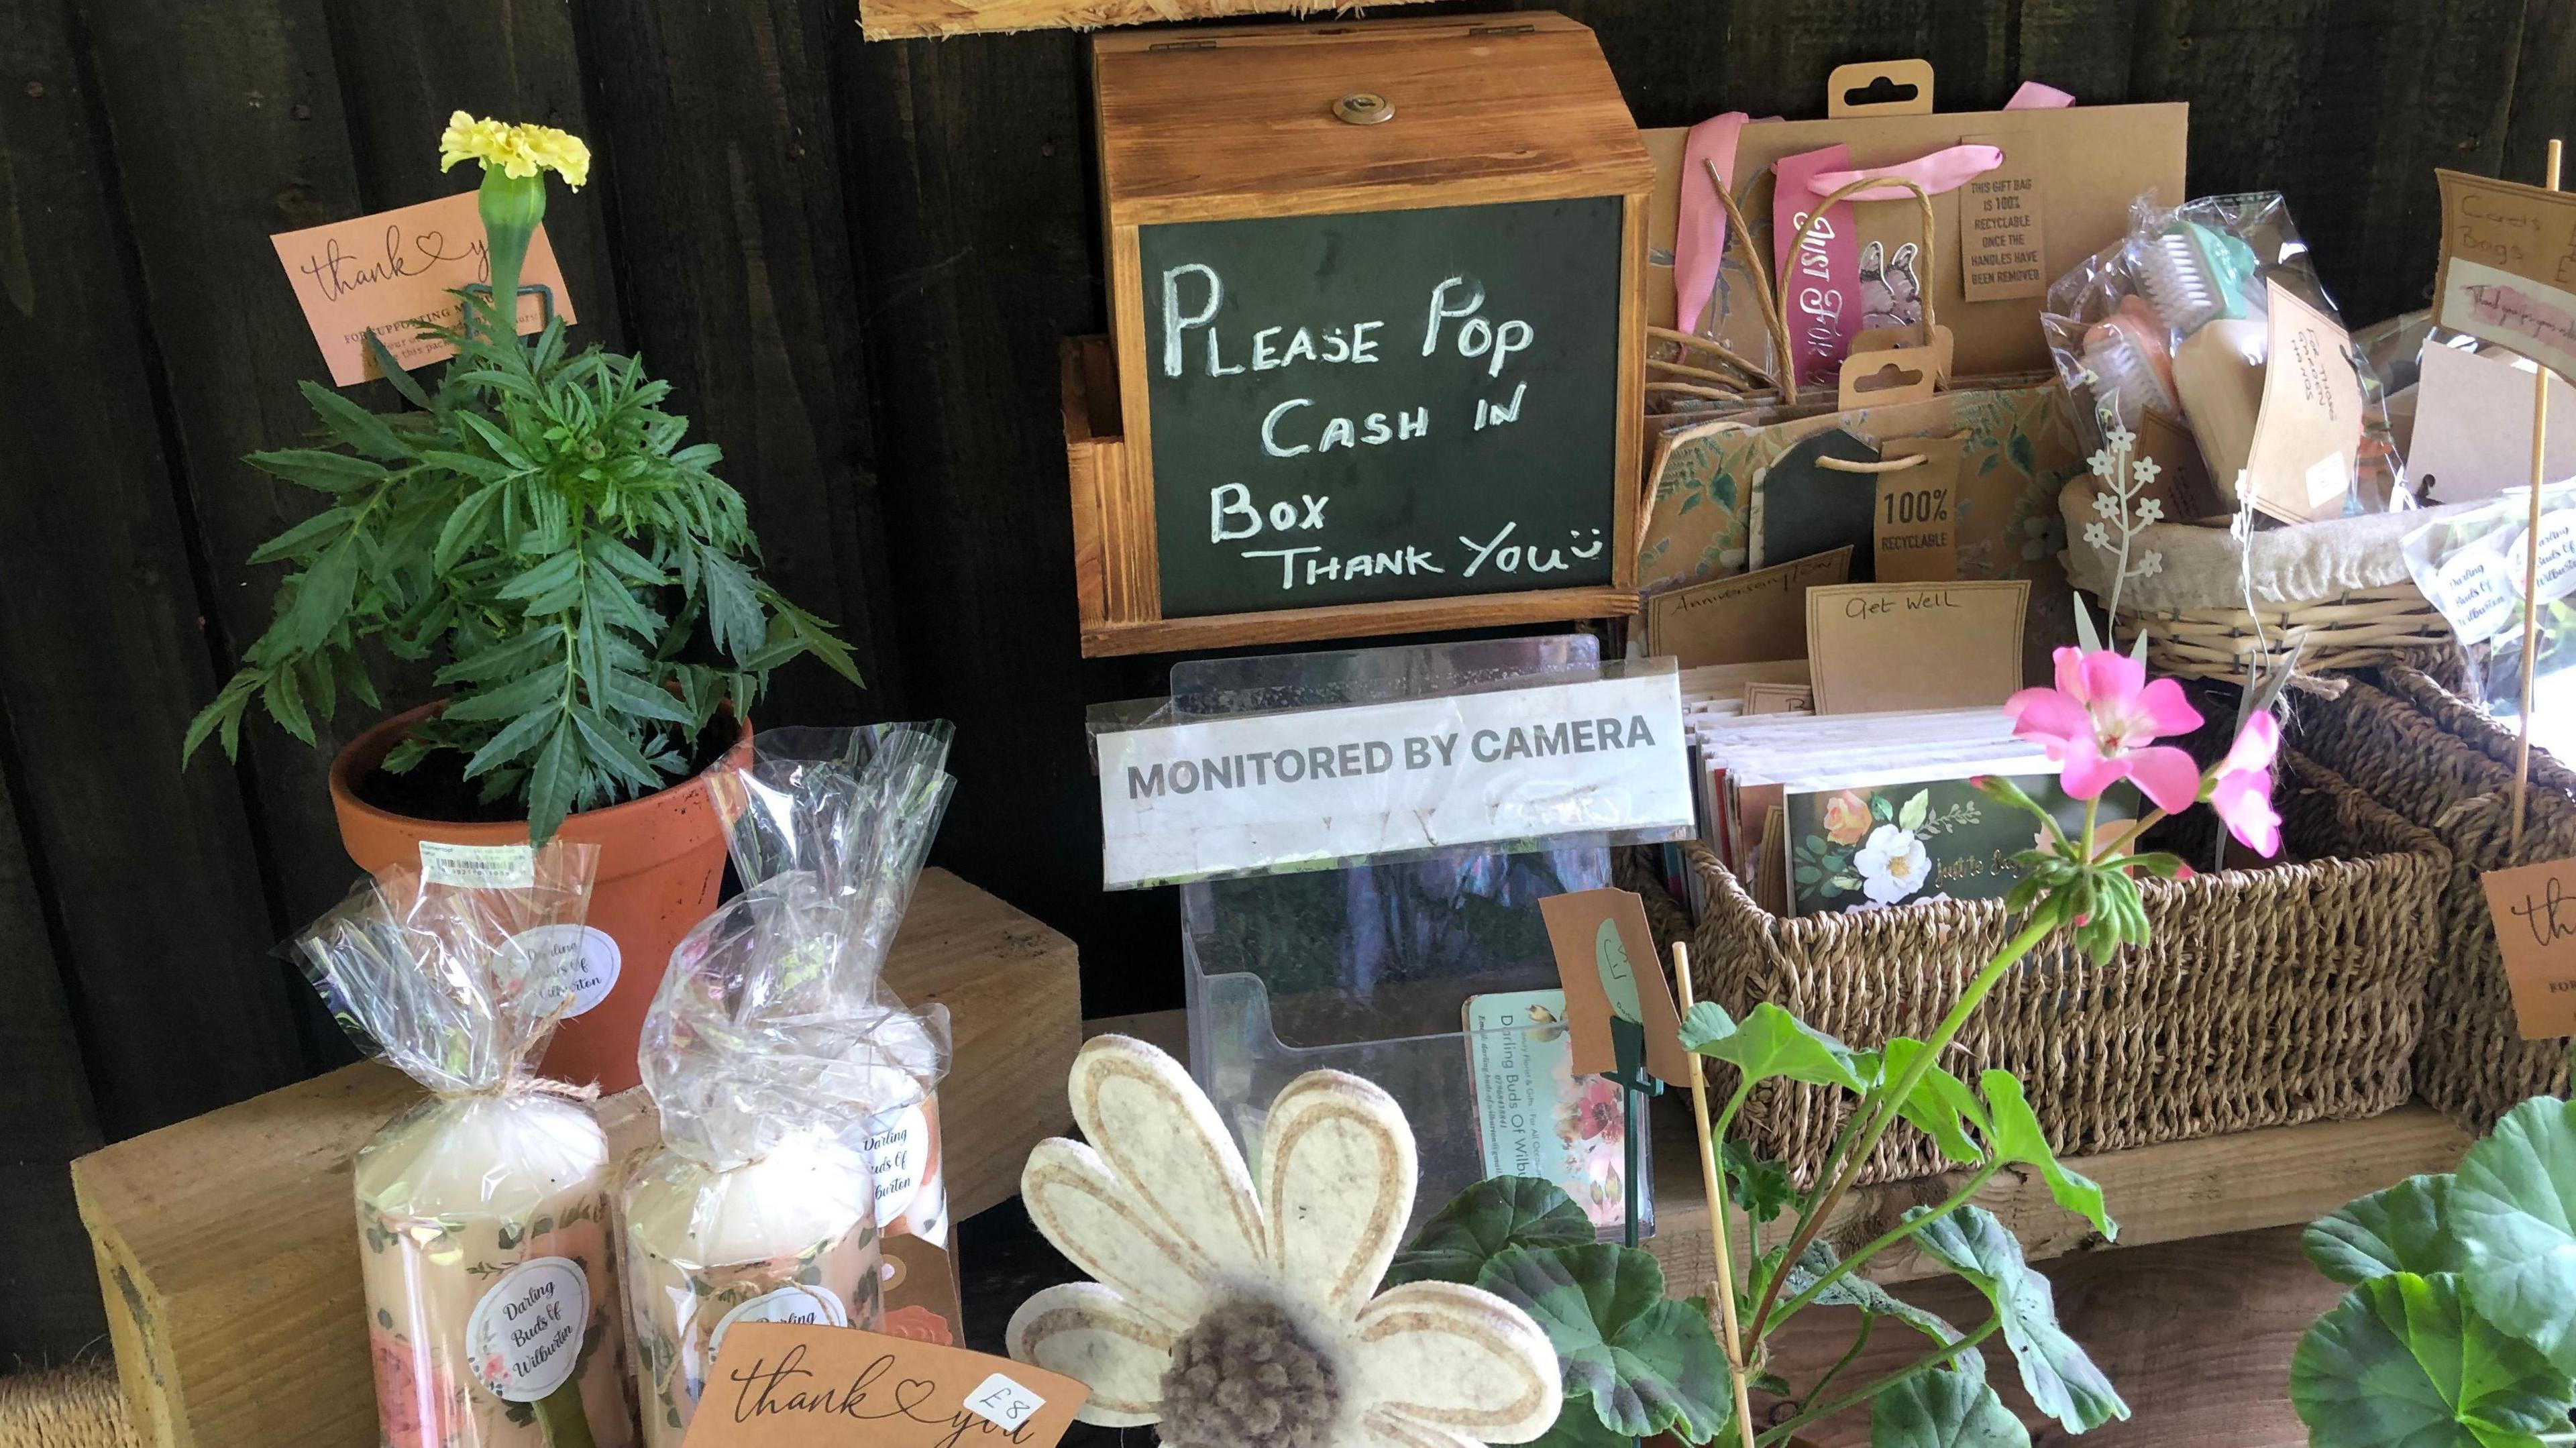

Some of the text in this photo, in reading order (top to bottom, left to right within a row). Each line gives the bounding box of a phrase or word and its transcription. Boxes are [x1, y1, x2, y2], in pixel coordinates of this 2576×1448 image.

[1971, 178, 2032, 194] THIS GIFT BAG
[1984, 196, 2021, 211] IS 100%
[1974, 215, 2031, 230] RECYCLABLE
[1982, 233, 2025, 247] ONCE THE
[301, 225, 411, 302] thank
[1971, 250, 2038, 266] HANDLES HAVE
[1972, 269, 2040, 285] BEEN REMOVED
[1163, 263, 1385, 378] PLEASE
[1260, 380, 1528, 458] CASH IN
[1884, 488, 1948, 524] 100%
[1881, 532, 1949, 552] RECYCLABLE
[1240, 545, 1446, 590] THANK
[1127, 715, 1656, 800] MONITORED BY CAMERA
[1506, 1074, 1520, 1109] Buds
[1510, 1114, 1526, 1134] Of
[894, 1150, 908, 1170] Of
[503, 1281, 555, 1322] Darling
[511, 1300, 562, 1348] Buds Of
[513, 1325, 573, 1378] Wilburton
[731, 1343, 872, 1424] thank
[979, 1387, 1031, 1420] £8
